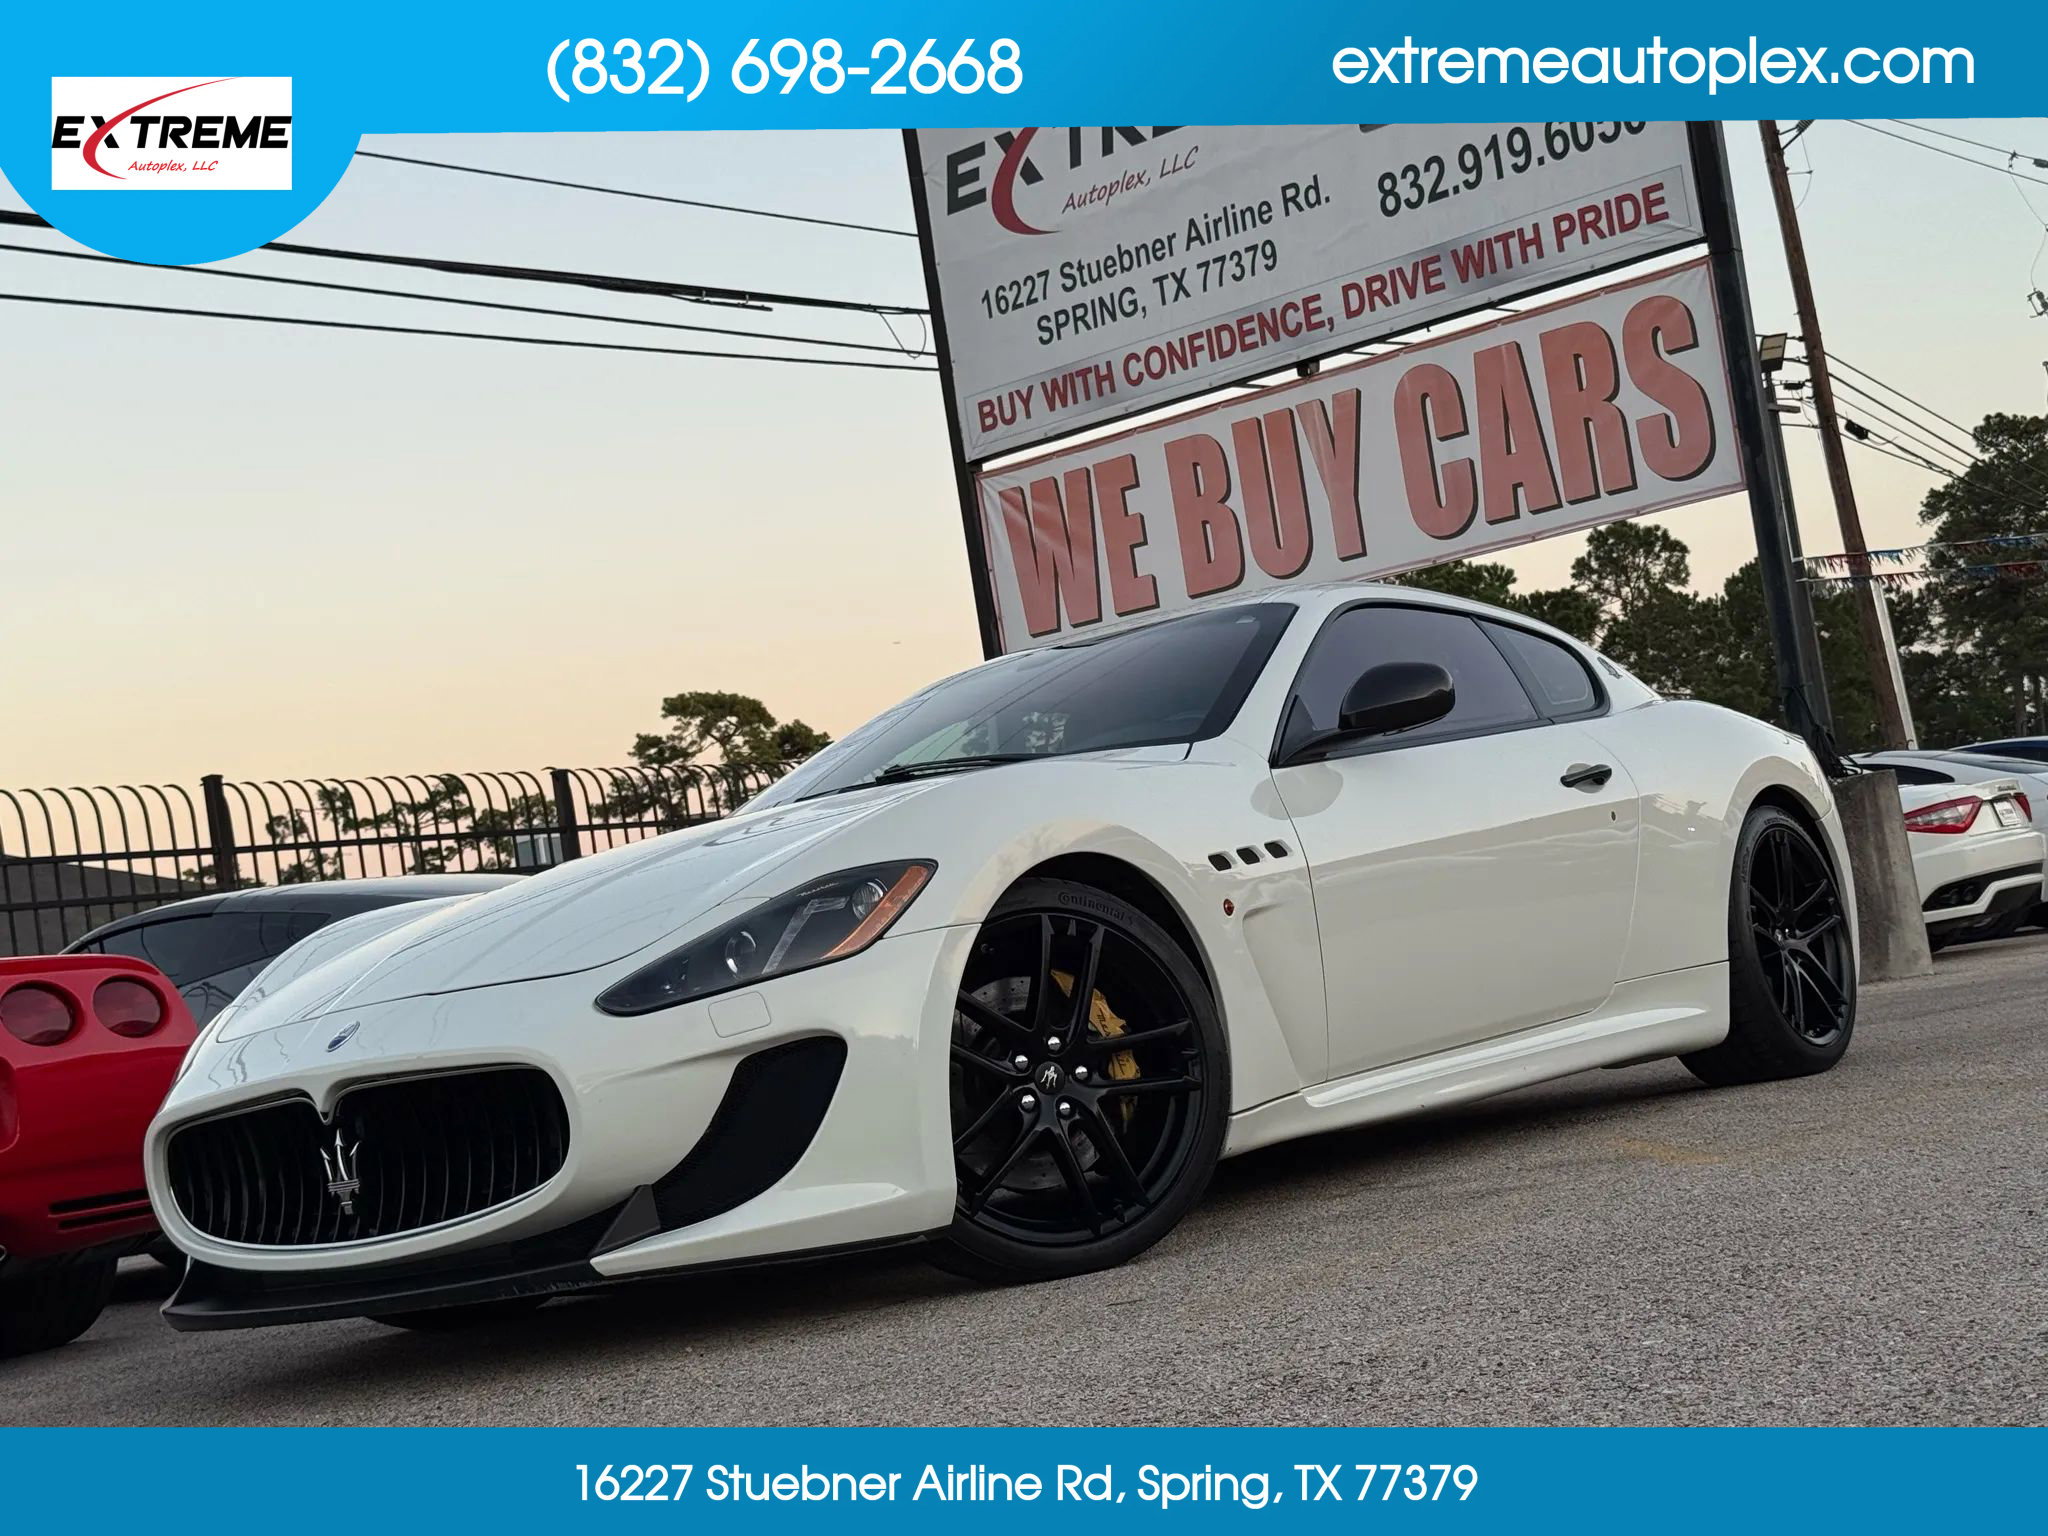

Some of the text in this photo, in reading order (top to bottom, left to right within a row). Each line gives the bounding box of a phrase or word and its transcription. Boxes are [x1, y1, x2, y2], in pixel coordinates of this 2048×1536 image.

[981, 174, 1331, 319] 16227 Stuebner Airline Rd.
[1062, 146, 1199, 214] Autoplex, LLC
[977, 182, 1670, 433] BUY WITH CONFIDENCE, DRIVE WITH PRIDE
[1036, 239, 1278, 346] SPRING, TX 77379
[998, 295, 1716, 638] WE BUY CARS
